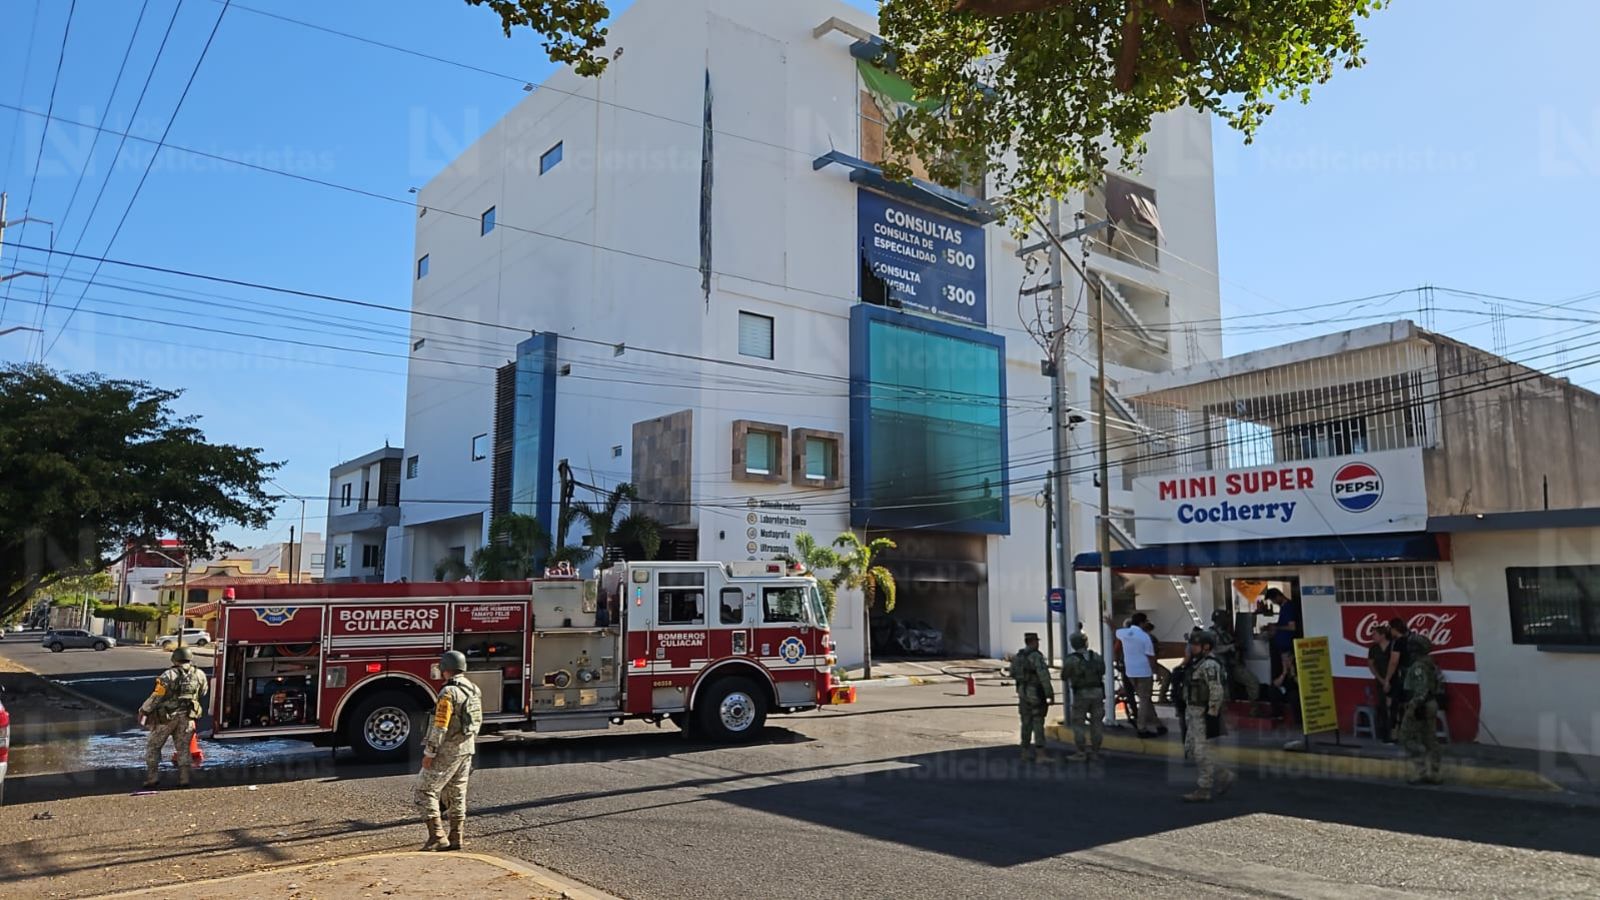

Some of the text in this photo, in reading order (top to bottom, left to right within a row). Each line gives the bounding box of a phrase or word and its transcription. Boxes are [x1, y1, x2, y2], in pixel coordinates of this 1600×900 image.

[874, 223, 934, 250] CONSULTA DE
[885, 208, 962, 245] CONSULTAS
[874, 237, 937, 263] ESPECIALIDAD
[942, 284, 976, 306] $300
[1159, 466, 1314, 501] MINI SUPER
[1335, 481, 1379, 494] PEPSI
[1177, 501, 1297, 524] Cocherry
[339, 608, 440, 621] BOMBEROS
[344, 619, 433, 632] CULIACAN
[657, 632, 706, 640] BOMBEROS
[660, 639, 703, 647] CULIACAN
